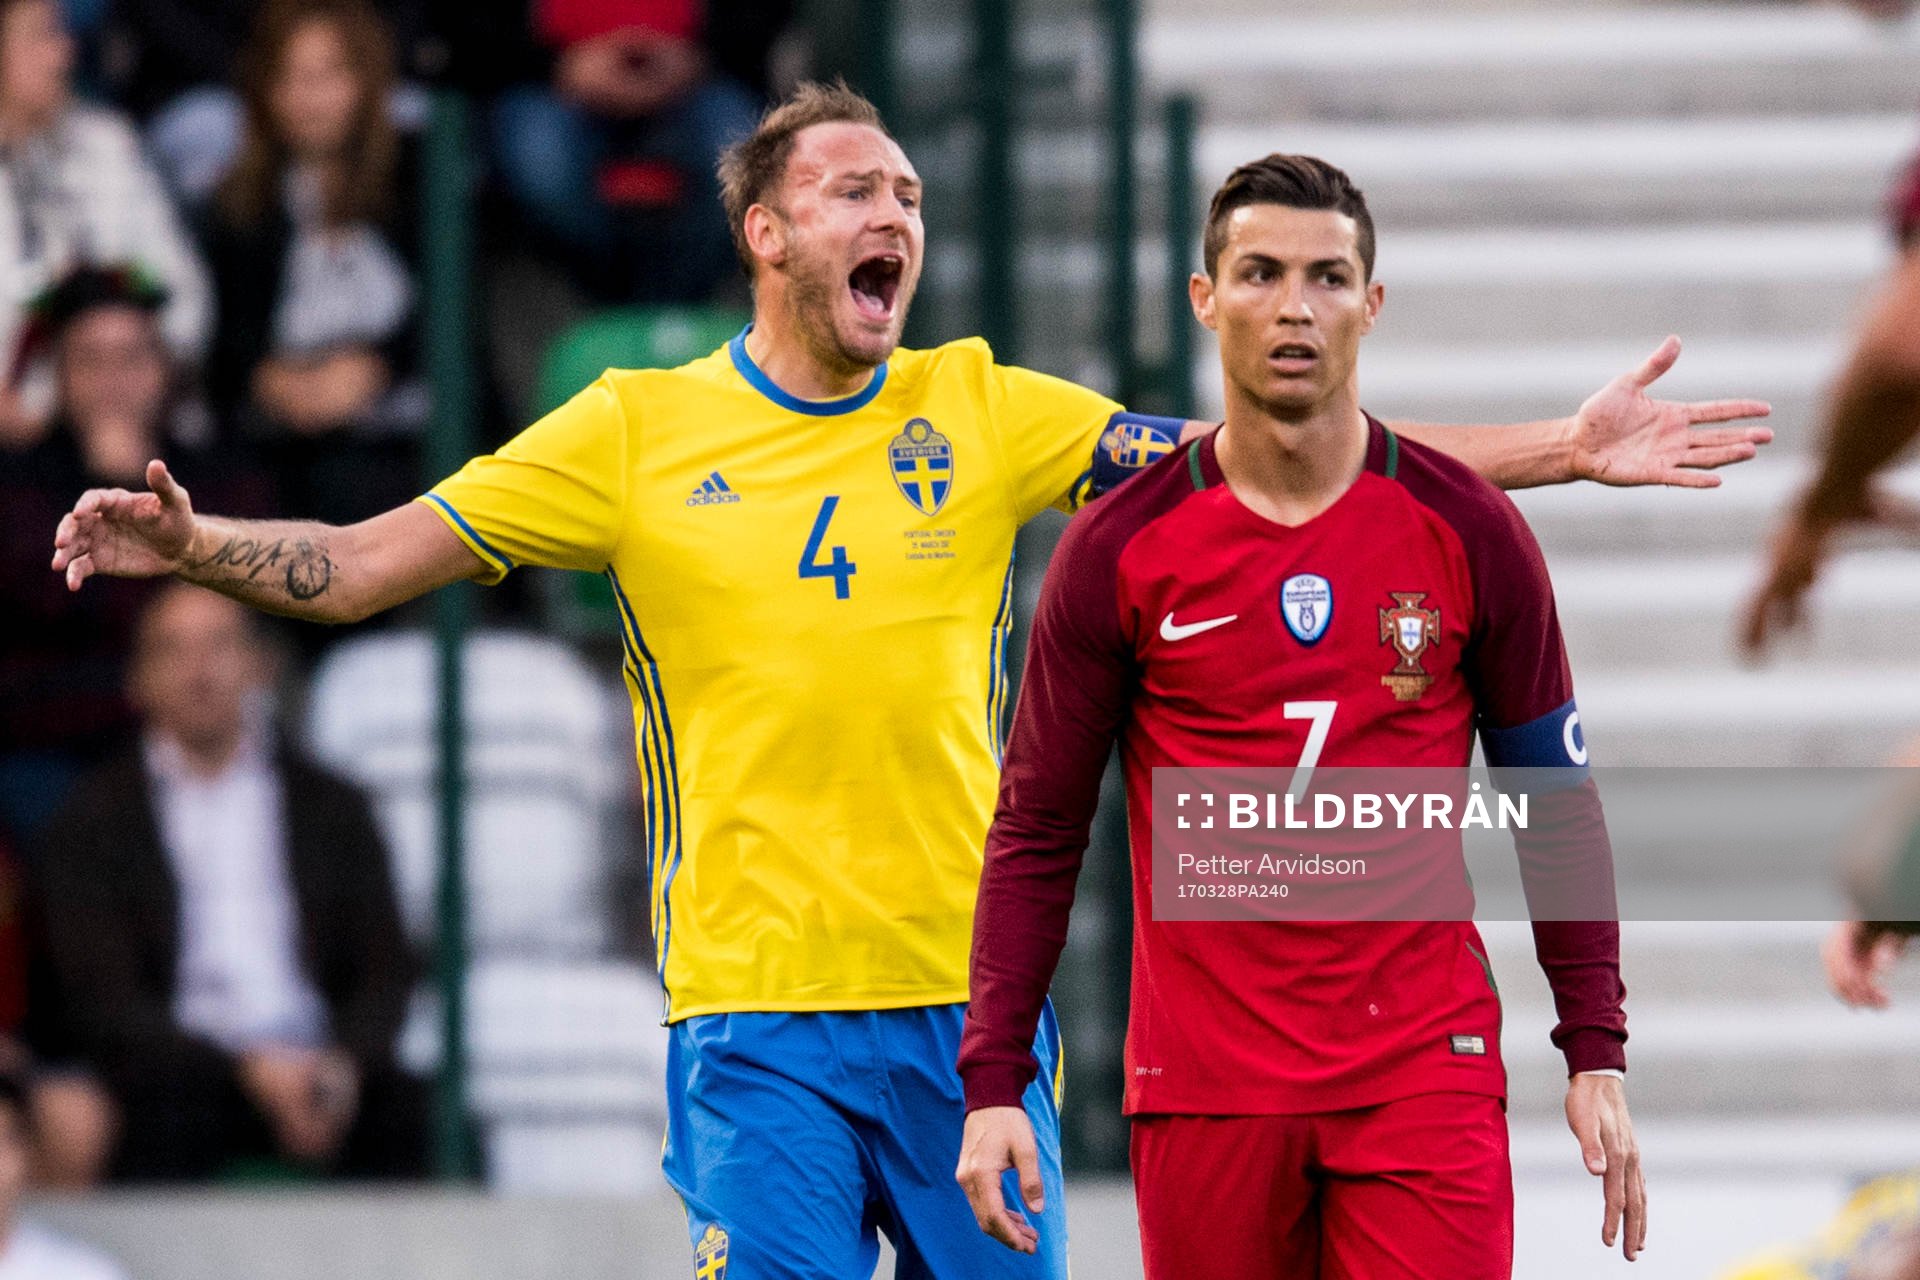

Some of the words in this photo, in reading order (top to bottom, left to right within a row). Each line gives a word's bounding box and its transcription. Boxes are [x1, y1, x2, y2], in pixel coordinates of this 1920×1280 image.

[686, 492, 741, 507] adidas
[798, 496, 857, 600] 4
[1283, 701, 1338, 805] 7
